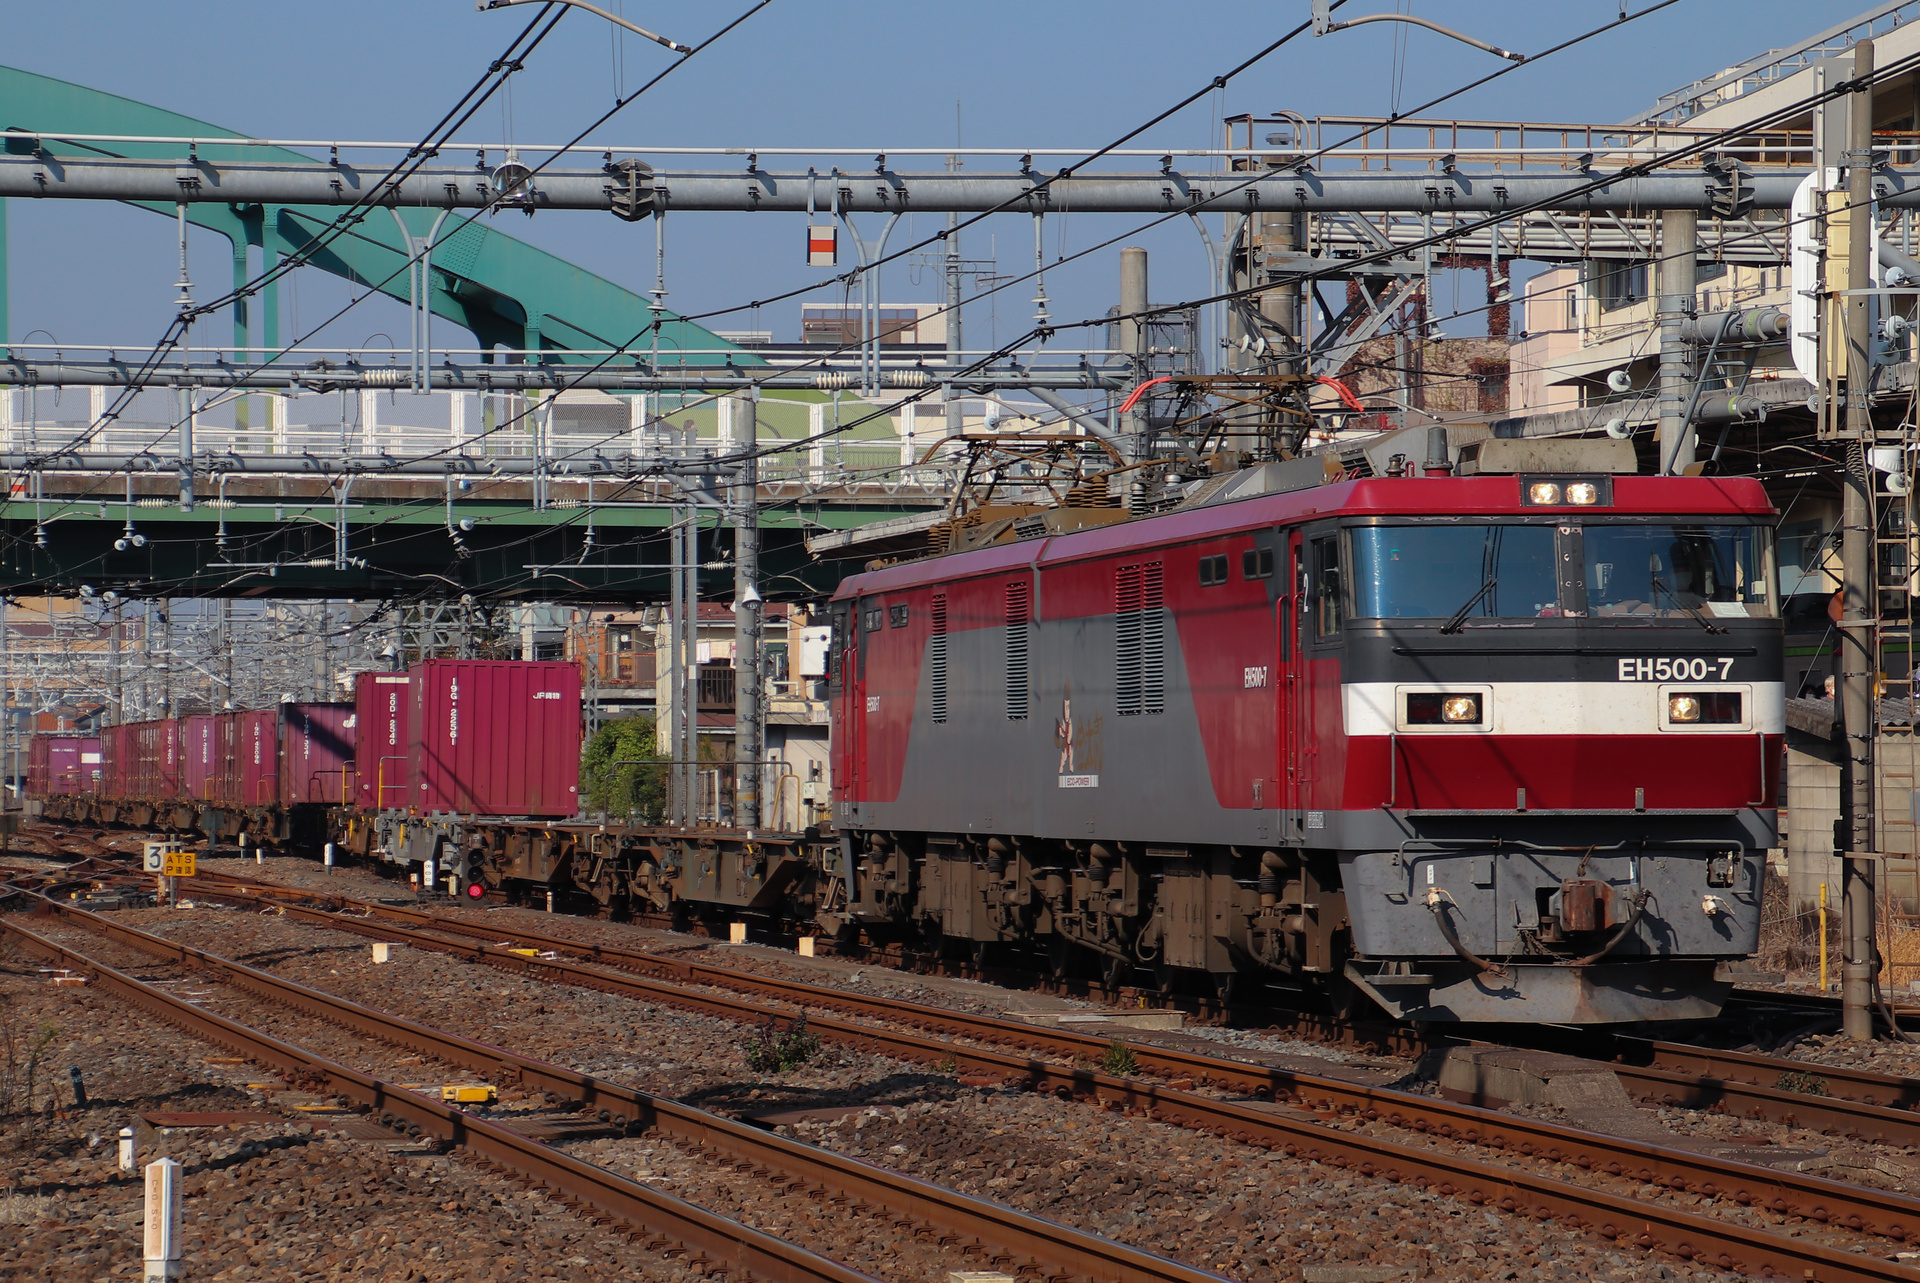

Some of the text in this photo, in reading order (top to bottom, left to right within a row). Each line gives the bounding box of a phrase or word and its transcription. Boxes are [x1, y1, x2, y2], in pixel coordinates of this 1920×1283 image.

[1244, 666, 1268, 688] EH500-7
[1618, 658, 1734, 681] EH500-7
[148, 846, 162, 869] 3
[166, 855, 192, 864] ATS
